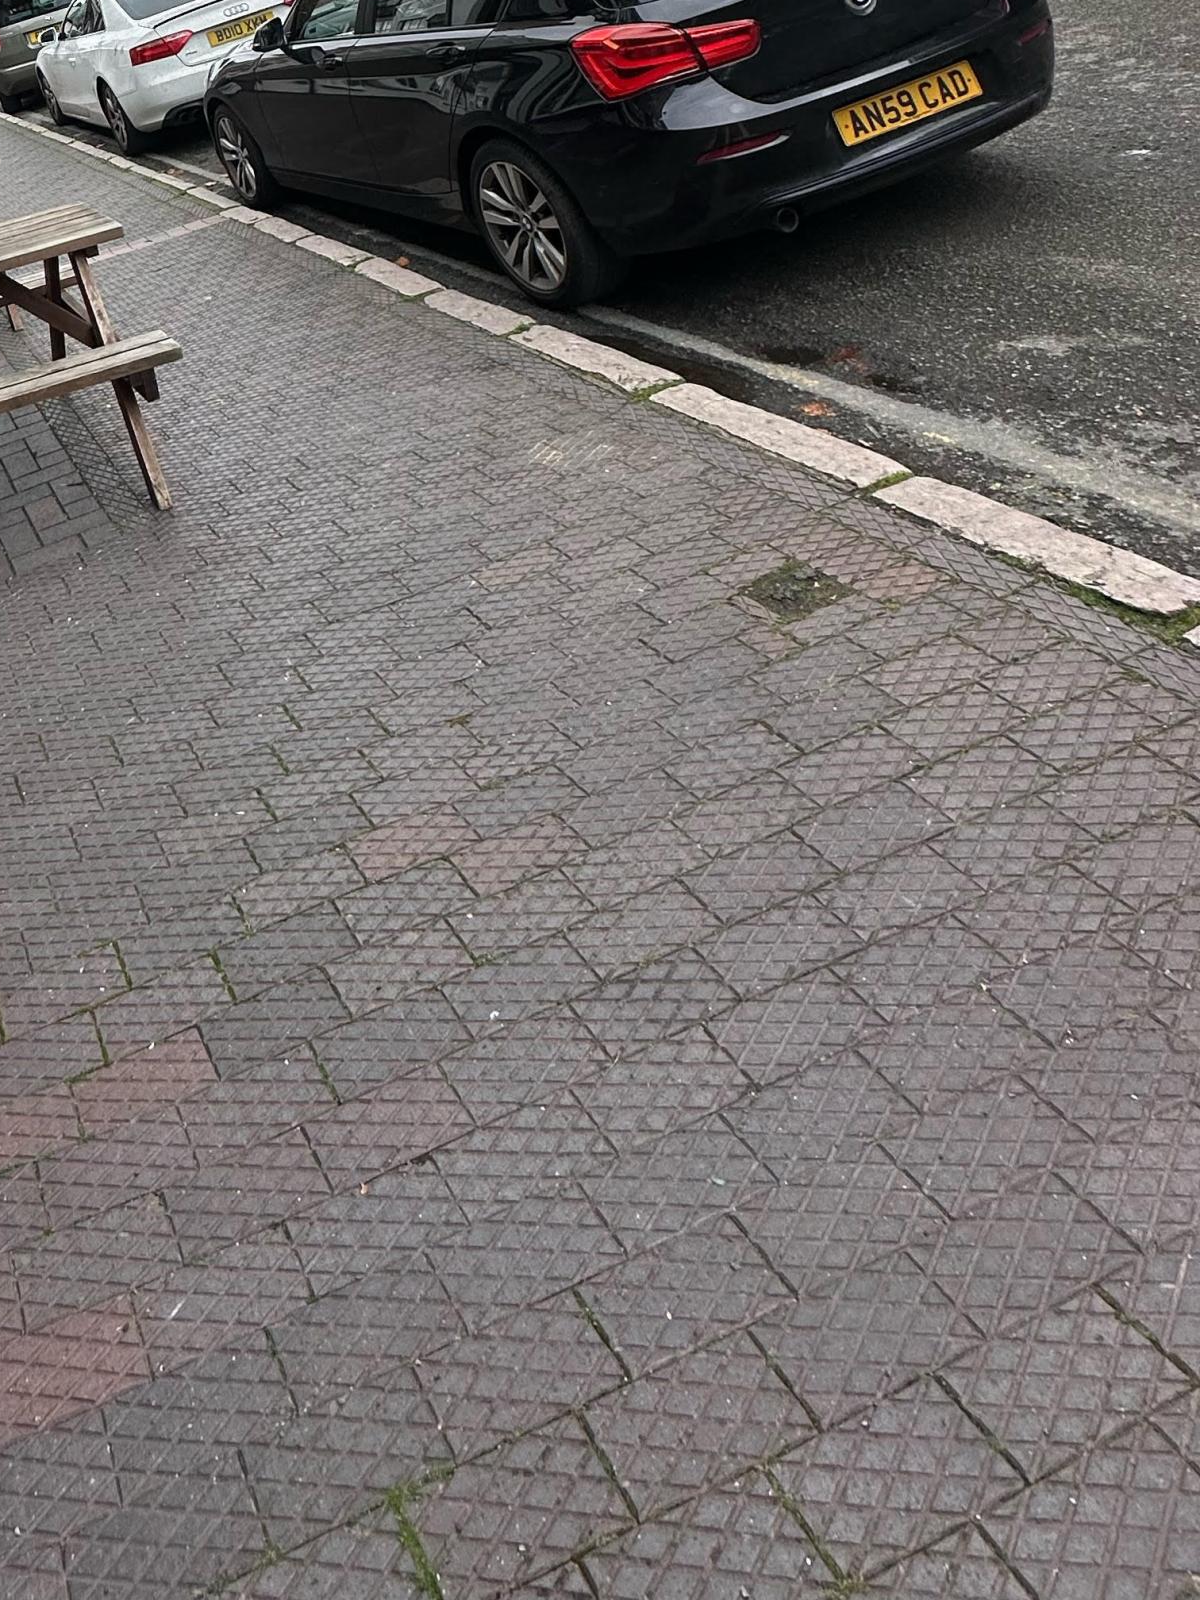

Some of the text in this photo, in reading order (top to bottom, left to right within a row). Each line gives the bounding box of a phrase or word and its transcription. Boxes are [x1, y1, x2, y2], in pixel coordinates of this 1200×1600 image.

[214, 23, 243, 42] BD10
[848, 69, 969, 138] AN59 CAD
